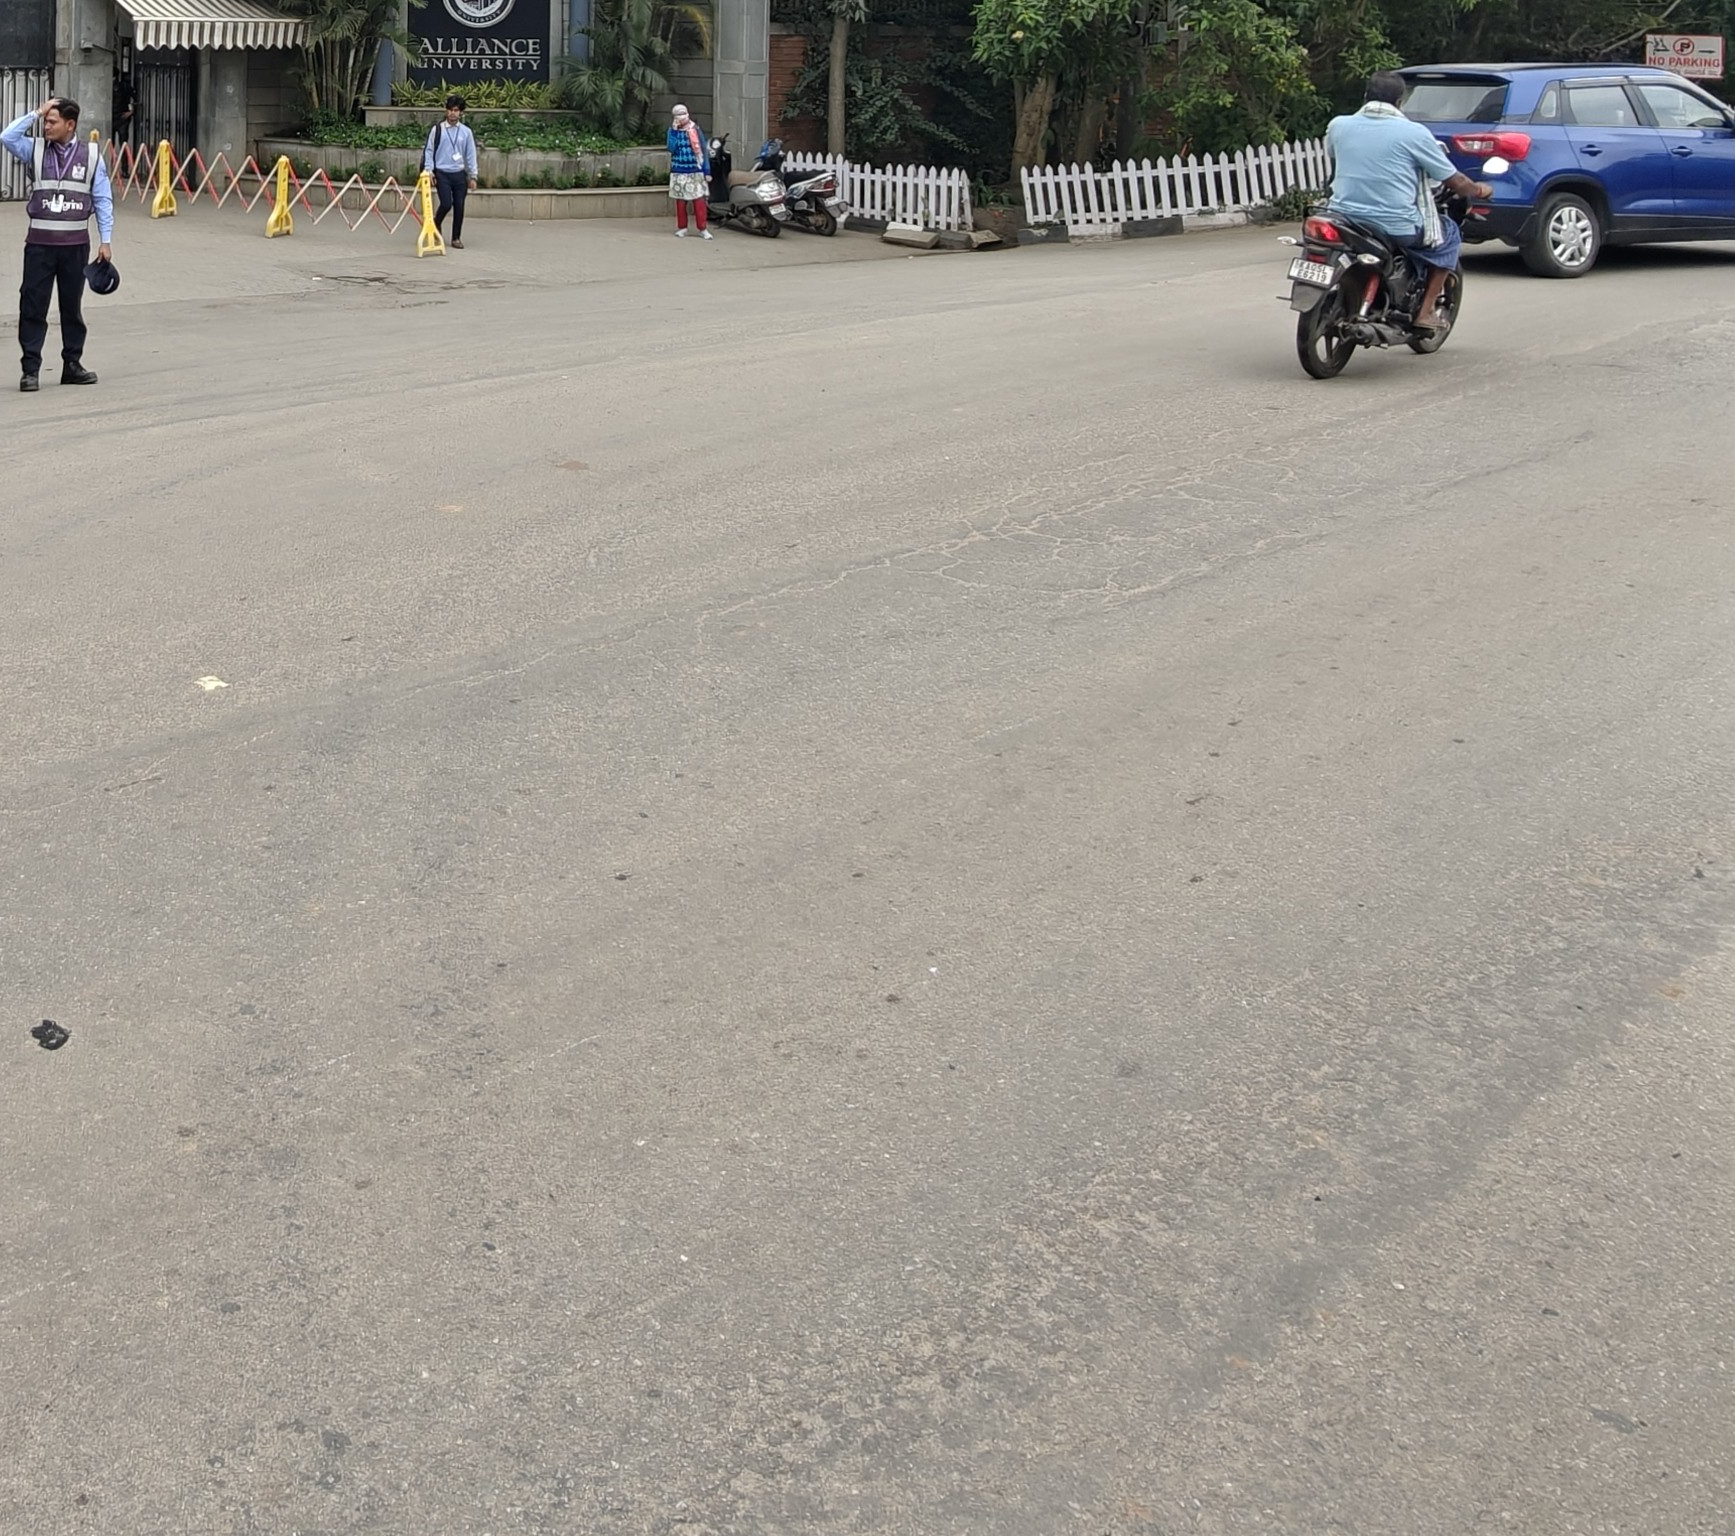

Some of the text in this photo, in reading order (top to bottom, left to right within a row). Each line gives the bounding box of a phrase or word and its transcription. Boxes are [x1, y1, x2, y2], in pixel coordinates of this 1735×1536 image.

[418, 37, 541, 55] ALLIANCE
[417, 58, 541, 70] UNIVERSITY
[1648, 56, 1720, 68] NO PARKING
[1296, 268, 1327, 282] E6219
